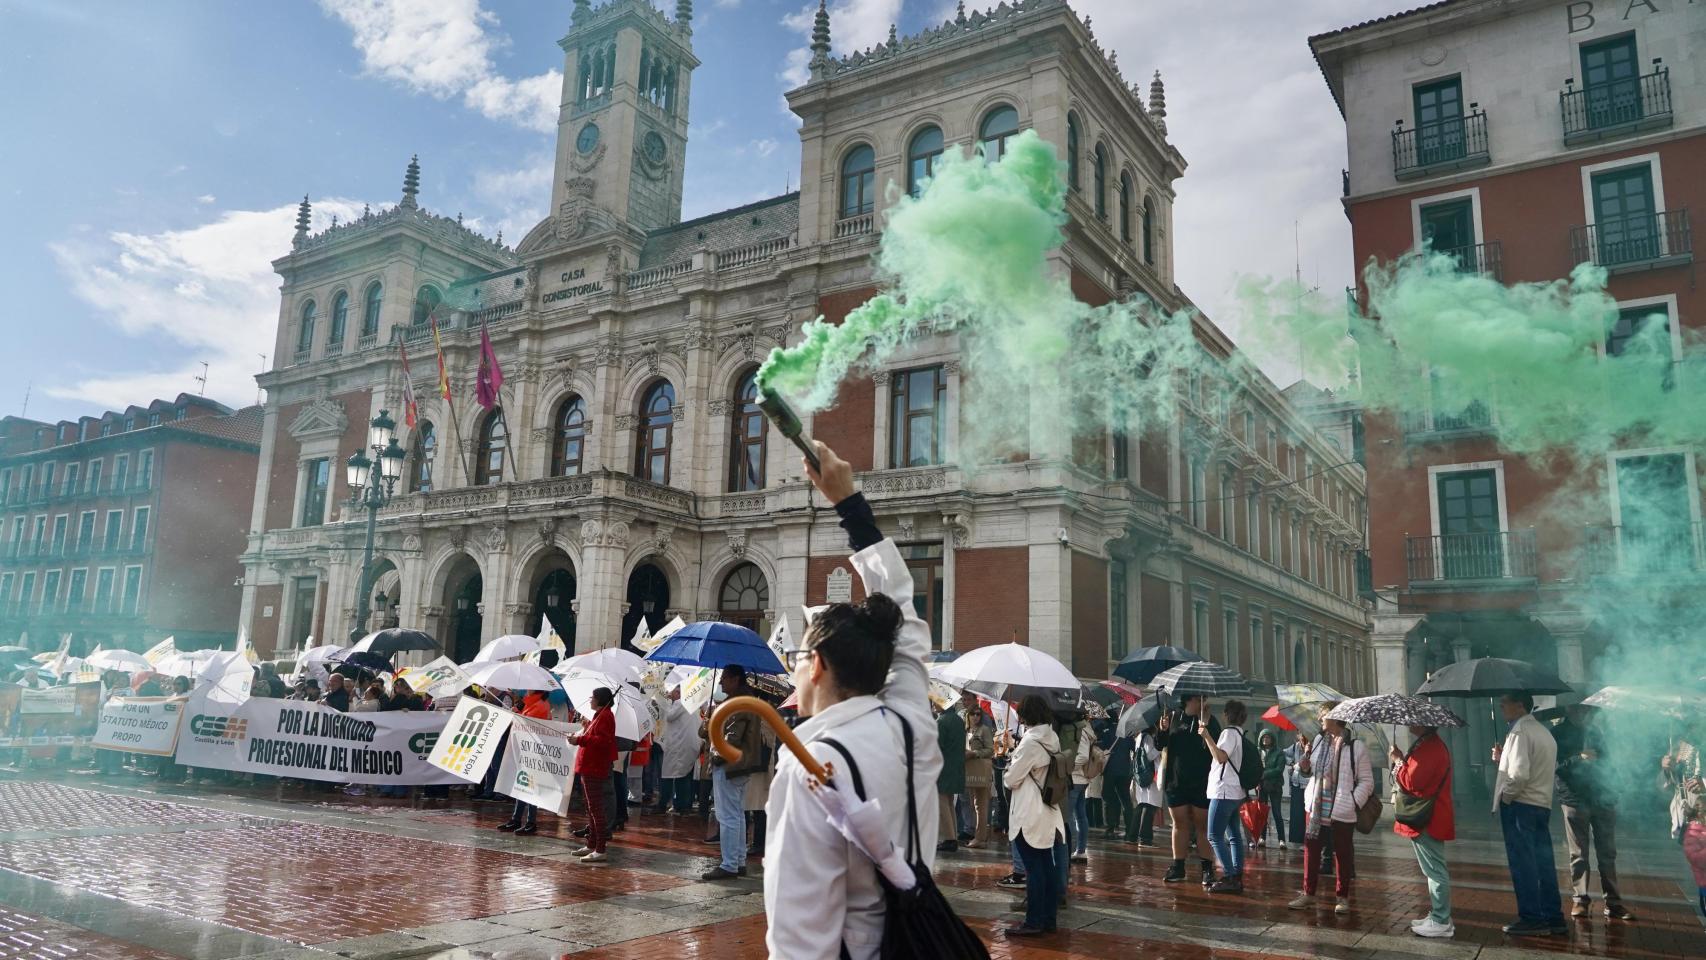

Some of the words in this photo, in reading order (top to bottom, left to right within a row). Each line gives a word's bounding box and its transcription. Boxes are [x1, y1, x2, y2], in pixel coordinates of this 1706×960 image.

[561, 268, 585, 282] CASA
[542, 281, 603, 304] CONSISTORIAL
[122, 704, 138, 713] POR
[138, 705, 151, 714] UN
[101, 715, 139, 728] STATUTO
[139, 719, 169, 730] MÉDICO
[277, 708, 302, 735] POR
[303, 710, 321, 738] LA
[320, 712, 378, 743] DIGNIDAD
[111, 731, 142, 743] PROPIO
[248, 737, 328, 770] PROFESIONAL
[329, 745, 349, 773] DEL
[351, 745, 404, 776] MÉDICO
[524, 756, 537, 771] HAY
[537, 759, 570, 777] SANIDAD
